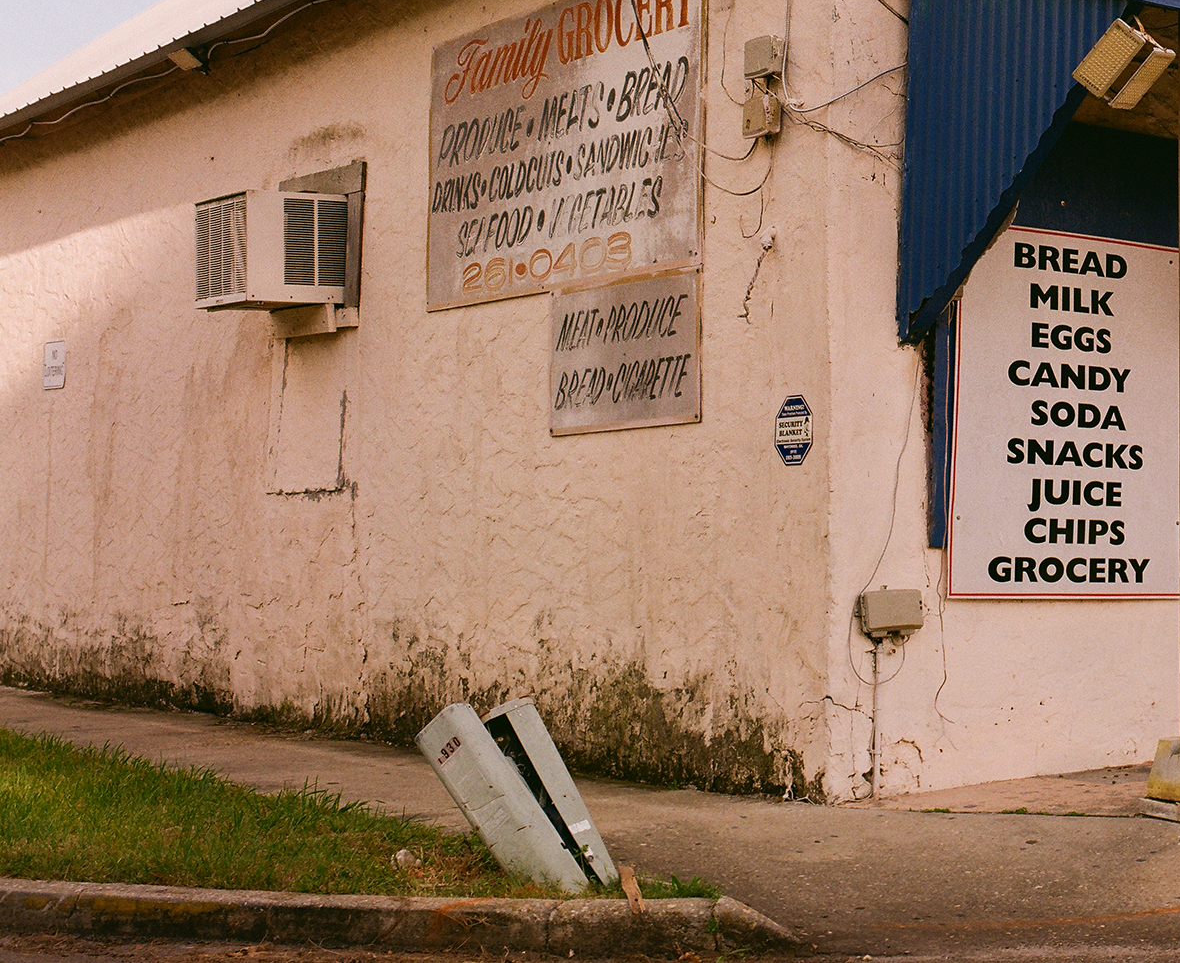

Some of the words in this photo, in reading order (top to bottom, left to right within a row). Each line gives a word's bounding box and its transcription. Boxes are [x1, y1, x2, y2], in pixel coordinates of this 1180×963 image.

[443, 17, 553, 105] Family
[437, 105, 526, 169] PRODUCE
[538, 81, 604, 142] MEATS
[615, 56, 689, 122] BREAD
[432, 171, 481, 214] DRINKS
[489, 150, 564, 202] COLDCUTS
[1014, 242, 1128, 279] BREAD
[1030, 283, 1114, 316] MILK
[555, 308, 599, 352] MEAT
[603, 294, 688, 345] PRODUCE
[1031, 322, 1112, 354] EGGS
[554, 366, 606, 410] BREAD
[612, 353, 692, 404] CIGARETTE
[1008, 360, 1131, 393] CANDY
[779, 420, 803, 428] SECURITY
[1030, 400, 1126, 431] SODA
[779, 429, 803, 437] BLANKET
[1006, 437, 1143, 470] SNACKS
[1027, 478, 1122, 512] JUICE
[1024, 517, 1125, 546] CHIPS
[988, 556, 1150, 584] GROCERY
